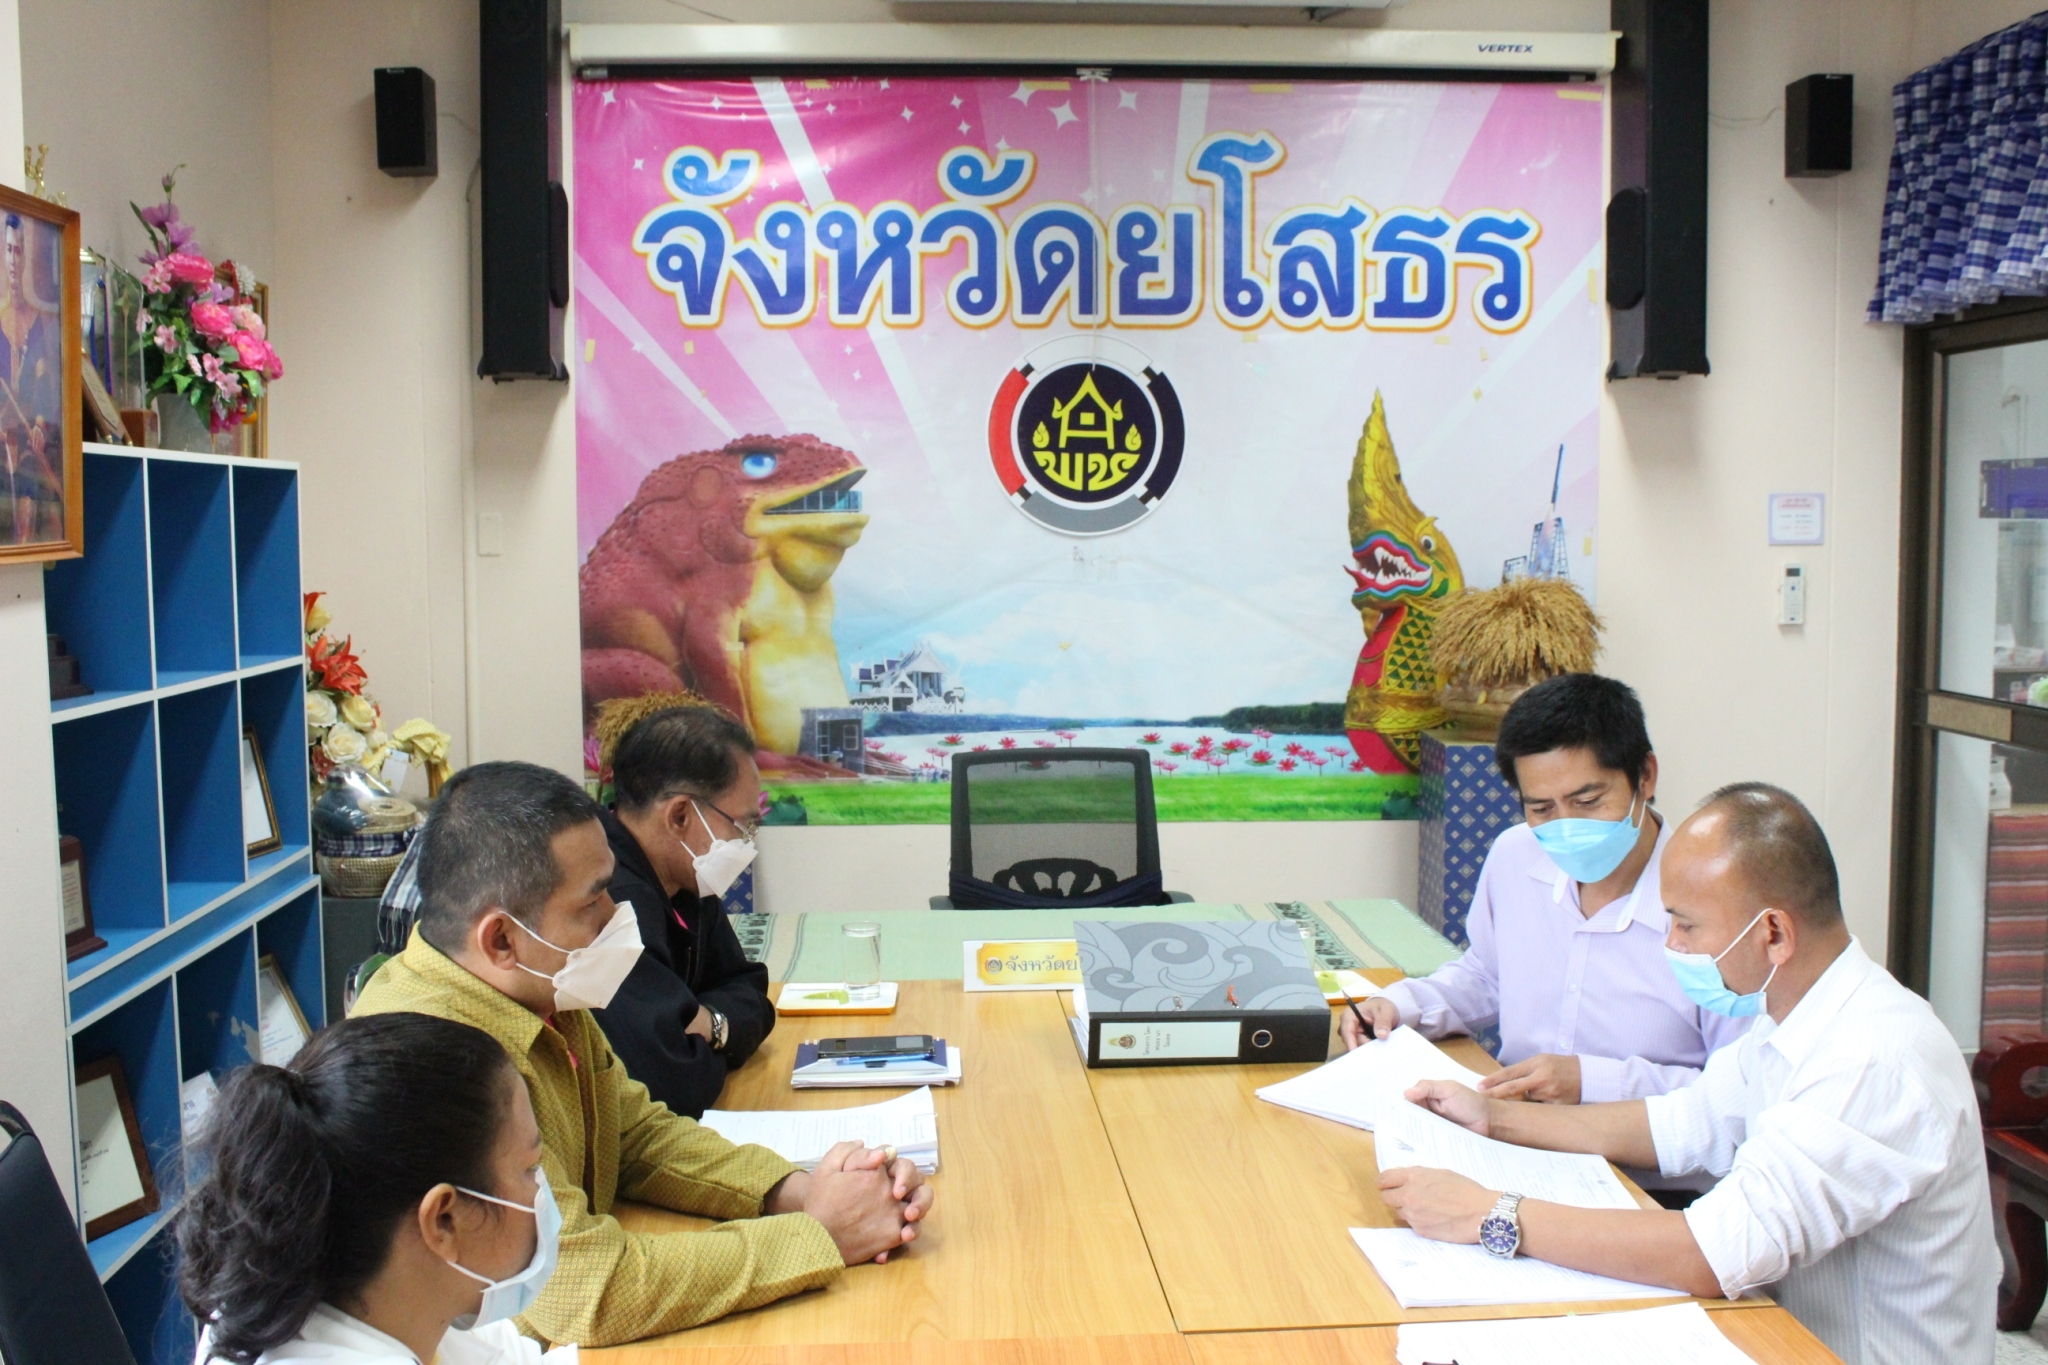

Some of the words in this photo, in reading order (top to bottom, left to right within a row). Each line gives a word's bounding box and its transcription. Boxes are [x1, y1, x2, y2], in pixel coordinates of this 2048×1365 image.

[1478, 43, 1533, 53] VERTEX
[636, 134, 1540, 328] จังหวัดยโสธร
[1005, 953, 1079, 972] จังหวัดย
